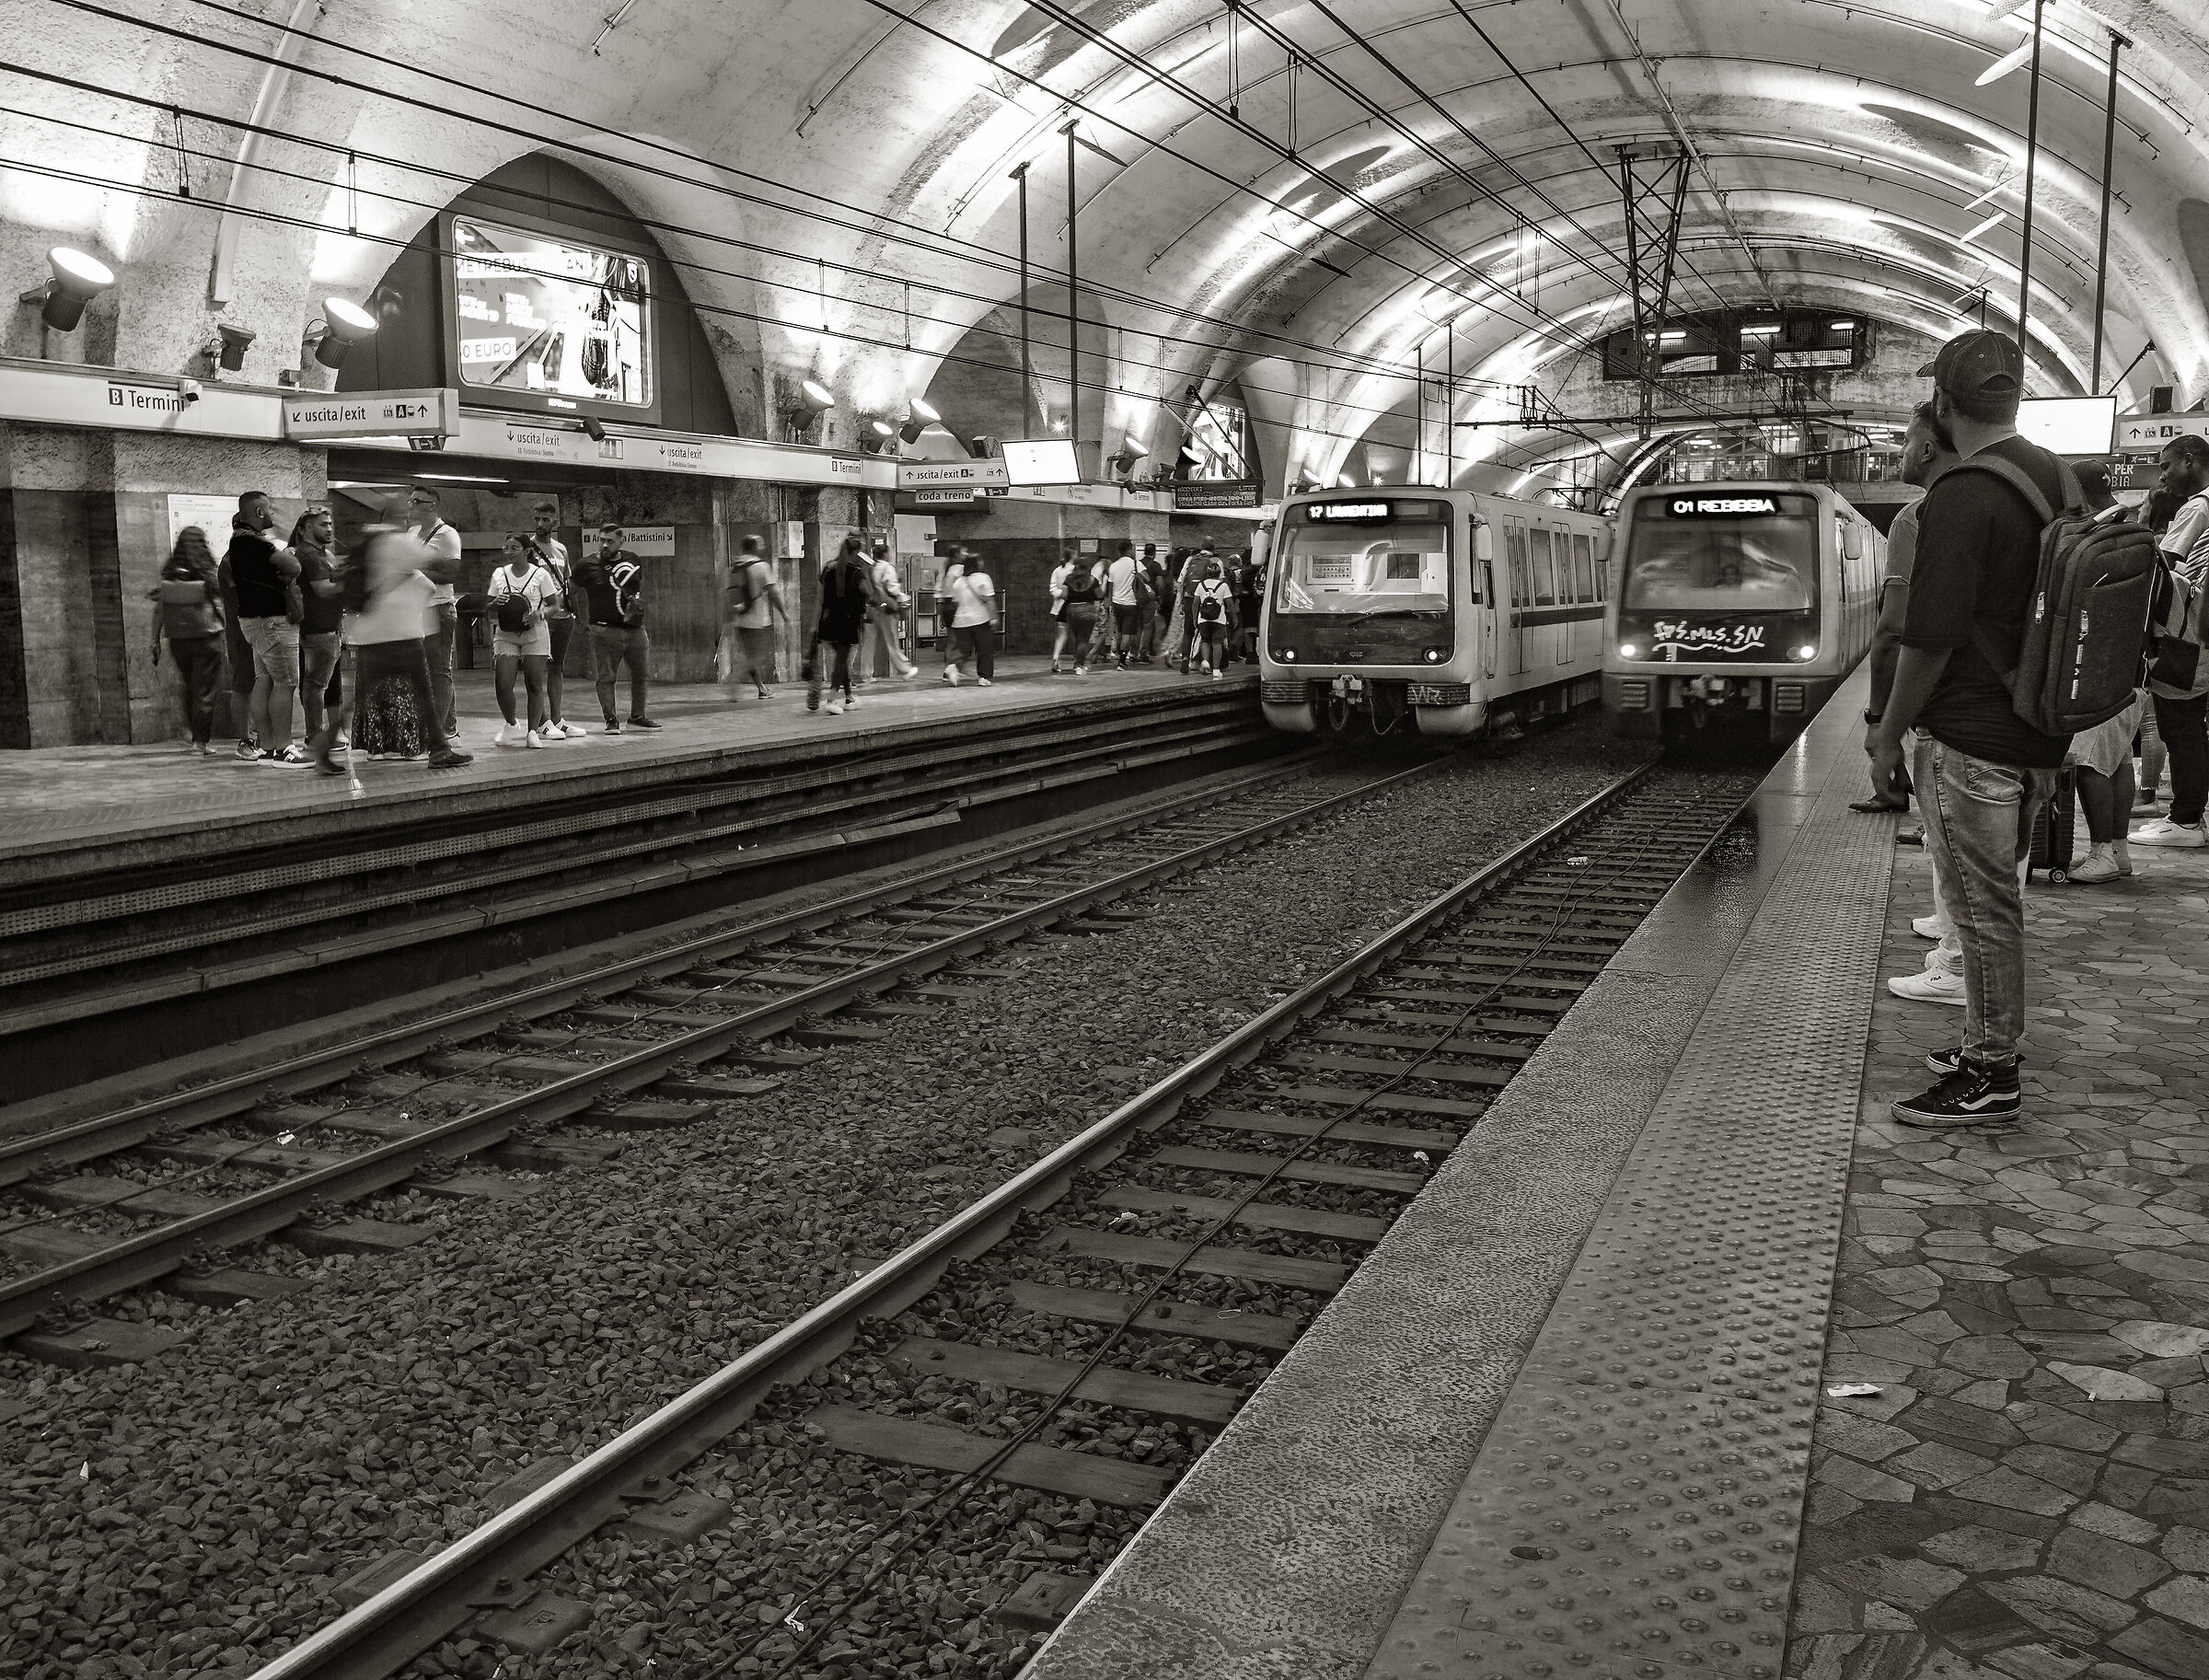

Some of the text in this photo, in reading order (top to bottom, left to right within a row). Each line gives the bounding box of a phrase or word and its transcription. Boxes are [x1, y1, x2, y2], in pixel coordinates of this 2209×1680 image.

[476, 342, 512, 356] EURO
[128, 390, 185, 411] Termini
[305, 405, 366, 423] uscita/exit
[516, 432, 561, 446] uscita/exit
[667, 447, 702, 459] uscita/exit
[838, 461, 862, 475] Termini
[2114, 464, 2134, 475] PER
[2111, 476, 2131, 487] BIA
[919, 491, 970, 501] coda treno
[1673, 499, 1775, 513] 01 REBIBBIA
[592, 533, 665, 542] Ana/Battistini
